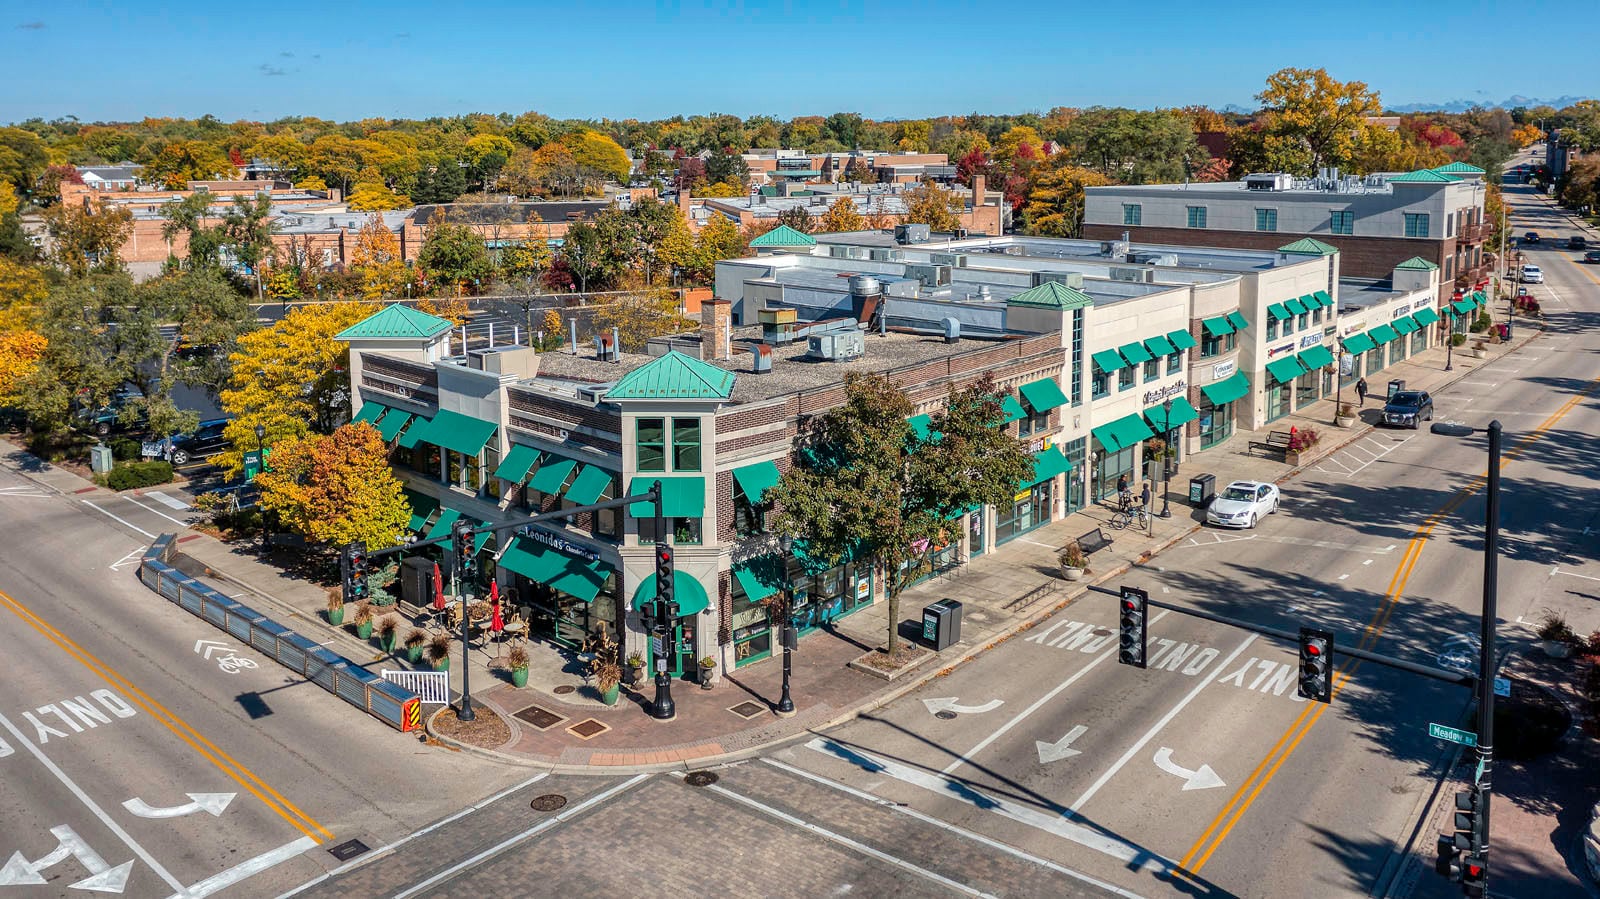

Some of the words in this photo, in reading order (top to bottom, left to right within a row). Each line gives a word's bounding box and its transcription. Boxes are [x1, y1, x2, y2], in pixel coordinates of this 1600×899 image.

[525, 526, 562, 550] Leonidas
[1024, 619, 1119, 654] ONLY
[22, 688, 137, 744] ONLY
[1433, 725, 1463, 741] Meadow
